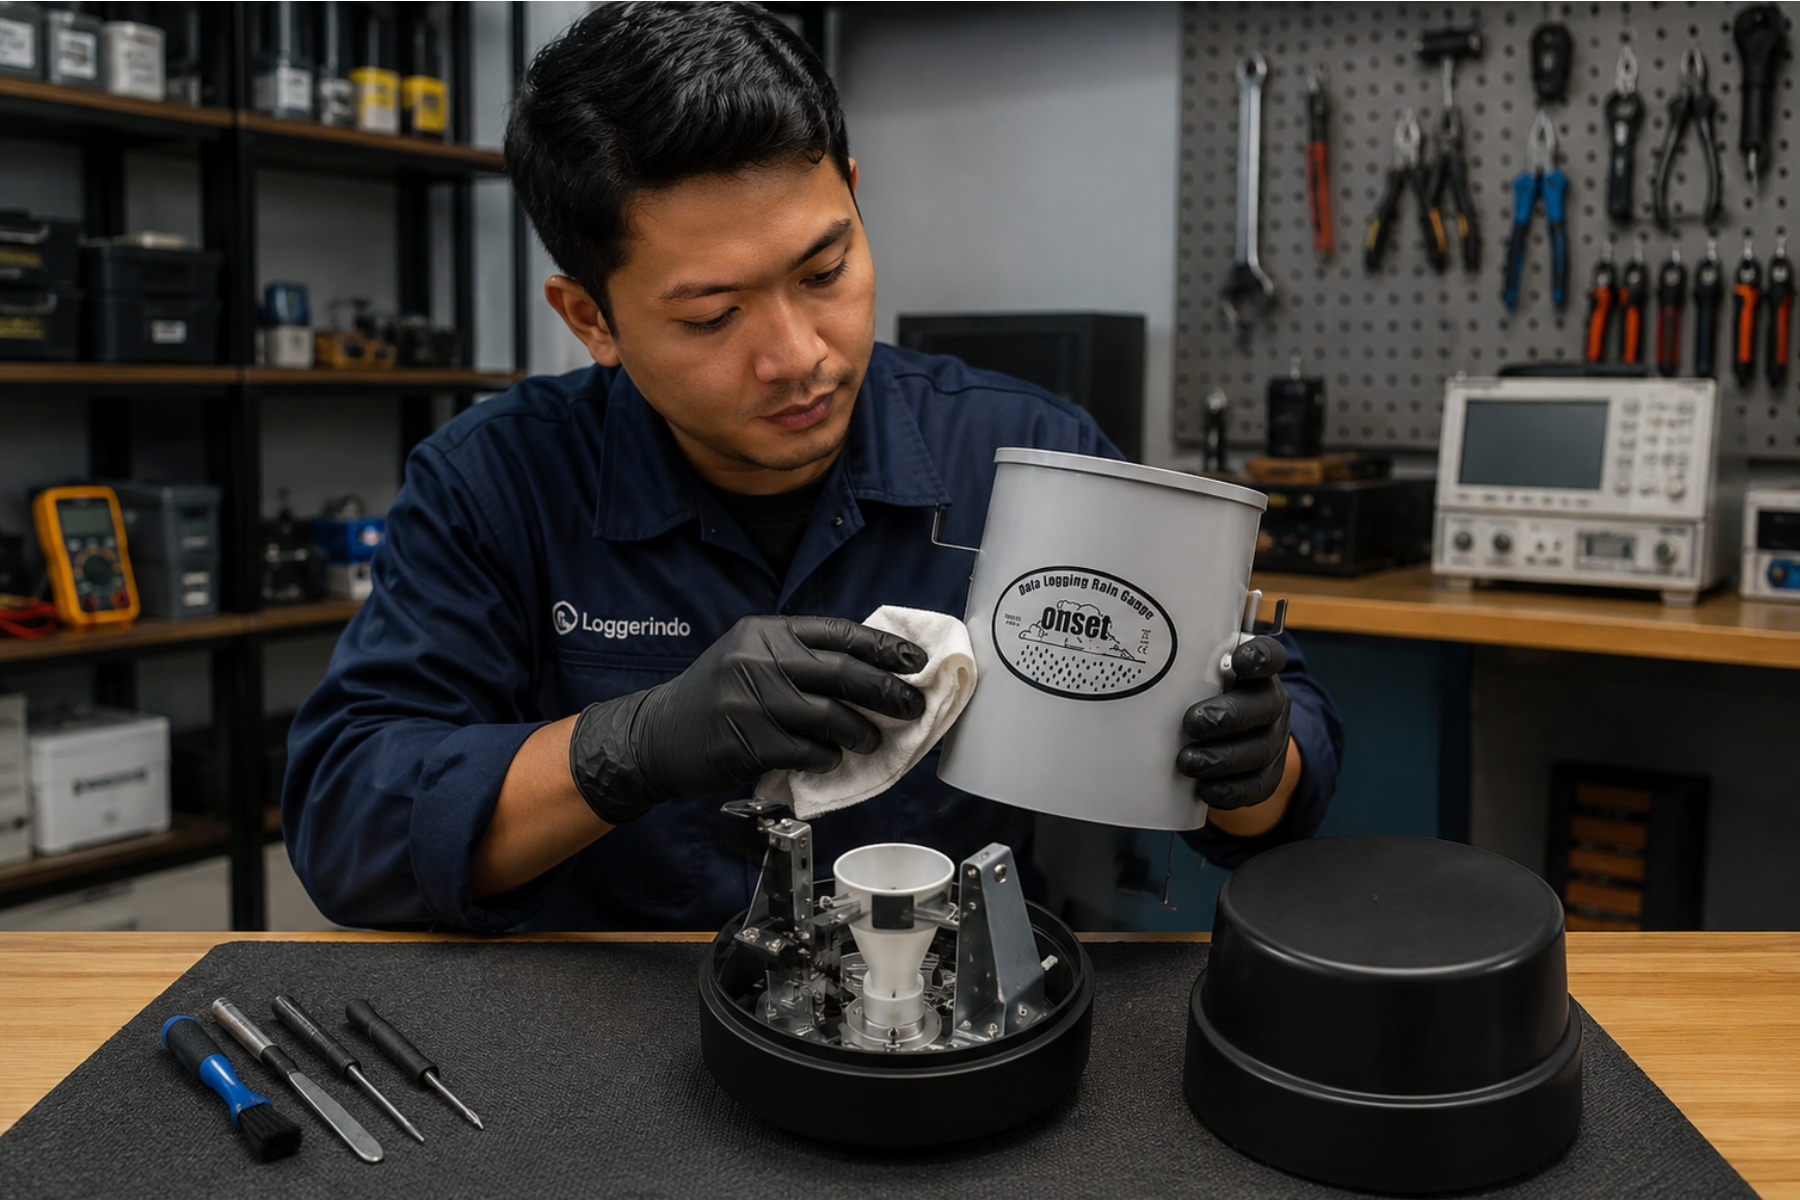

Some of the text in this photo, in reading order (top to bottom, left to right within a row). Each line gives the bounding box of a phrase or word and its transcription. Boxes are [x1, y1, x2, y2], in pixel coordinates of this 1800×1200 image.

[1018, 574, 1154, 620] Data Logging Rain Gauge
[582, 612, 691, 639] Loggerindo
[1041, 606, 1111, 641] onset
